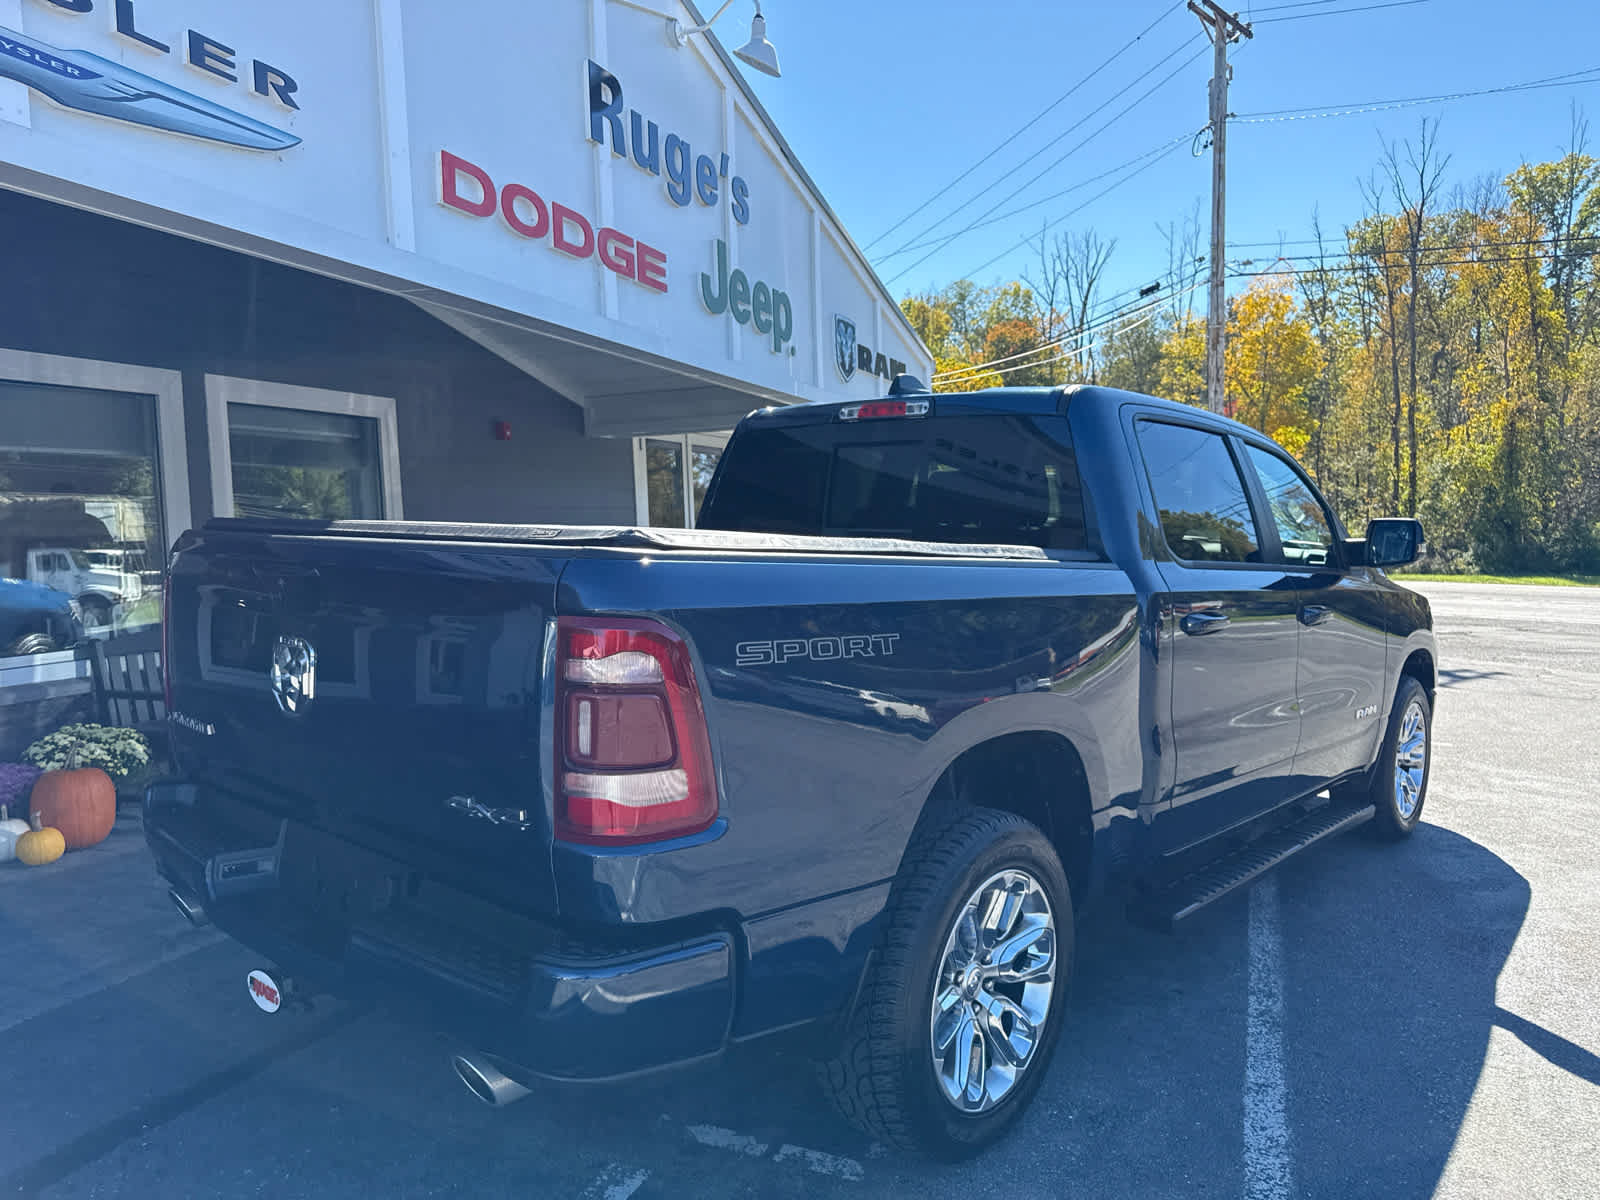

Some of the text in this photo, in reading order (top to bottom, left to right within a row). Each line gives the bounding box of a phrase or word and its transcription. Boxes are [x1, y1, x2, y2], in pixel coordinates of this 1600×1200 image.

[587, 60, 749, 225] Ruge's
[440, 150, 668, 293] DODGE
[736, 633, 900, 666] SPORT
